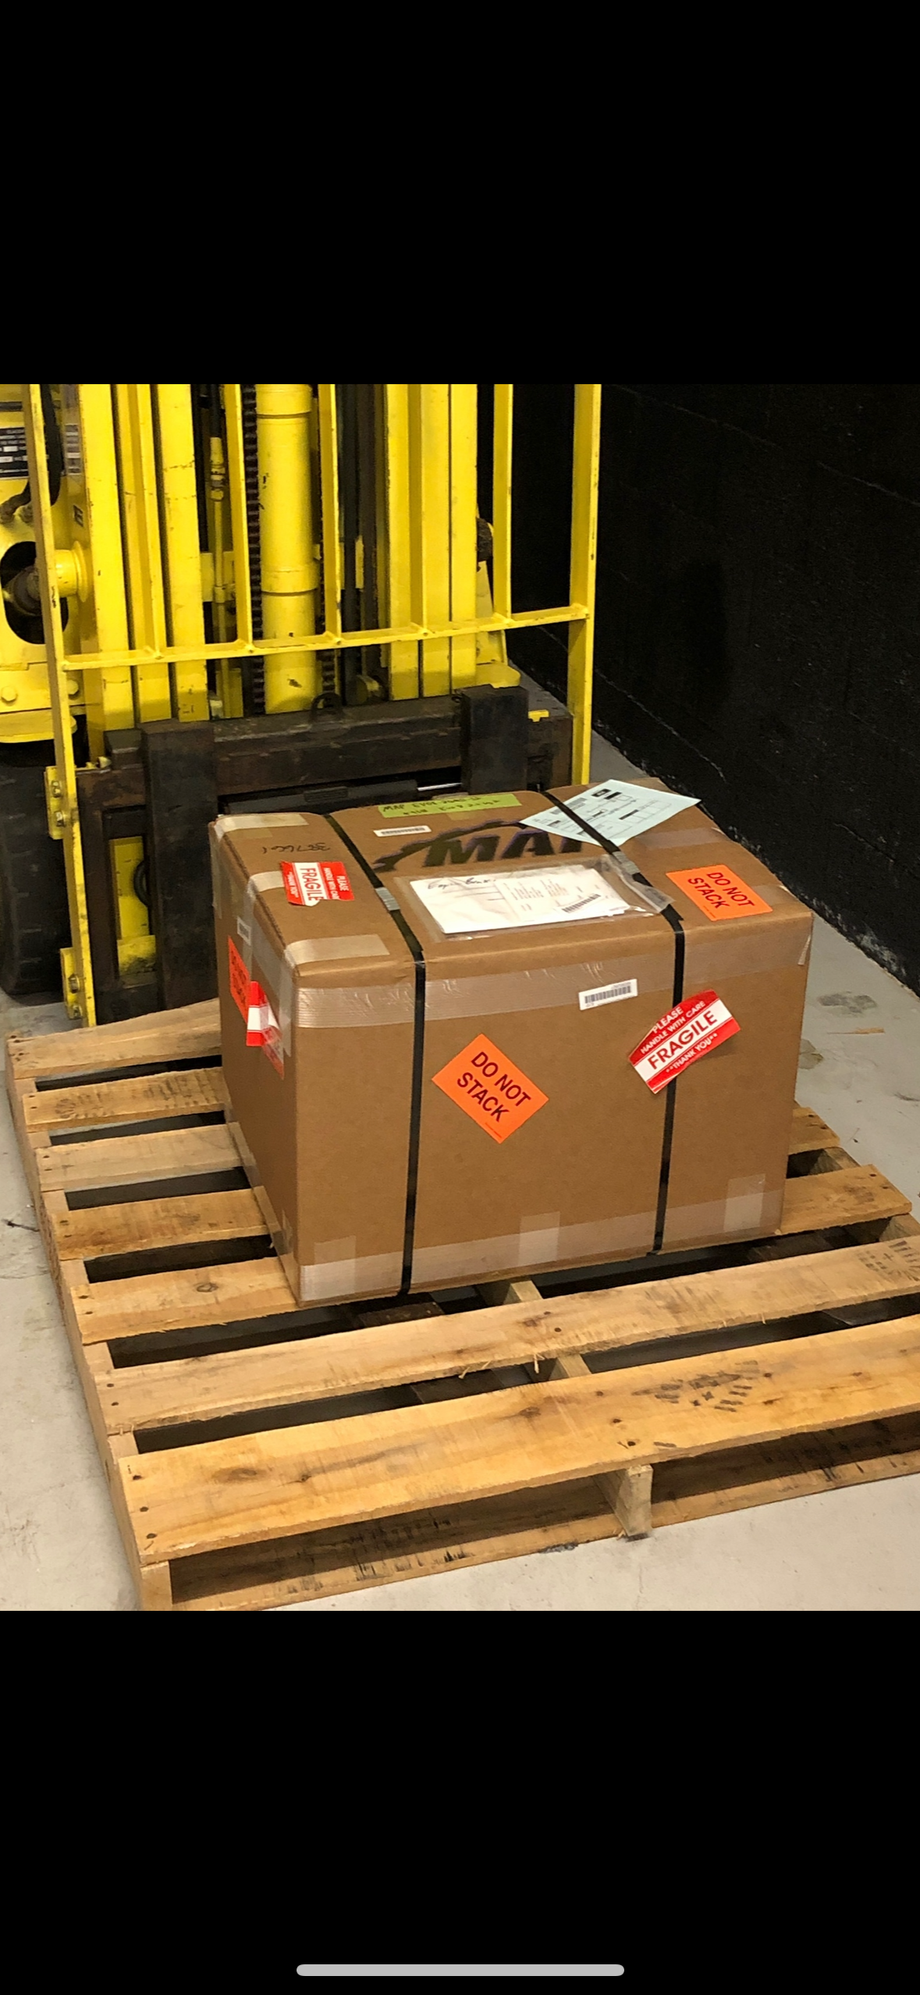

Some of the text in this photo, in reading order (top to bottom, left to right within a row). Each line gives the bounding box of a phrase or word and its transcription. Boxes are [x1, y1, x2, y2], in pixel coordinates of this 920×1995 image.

[300, 867, 325, 901] FRAGILE
[688, 877, 730, 909] STACK
[706, 872, 755, 907] DO NOT
[640, 1000, 706, 1054] HANDLE WITH CARE
[647, 1010, 718, 1070] FRAGILE
[651, 1006, 684, 1034] PLEASE
[457, 1072, 510, 1123] STACK
[471, 1051, 532, 1107] DO NOT
